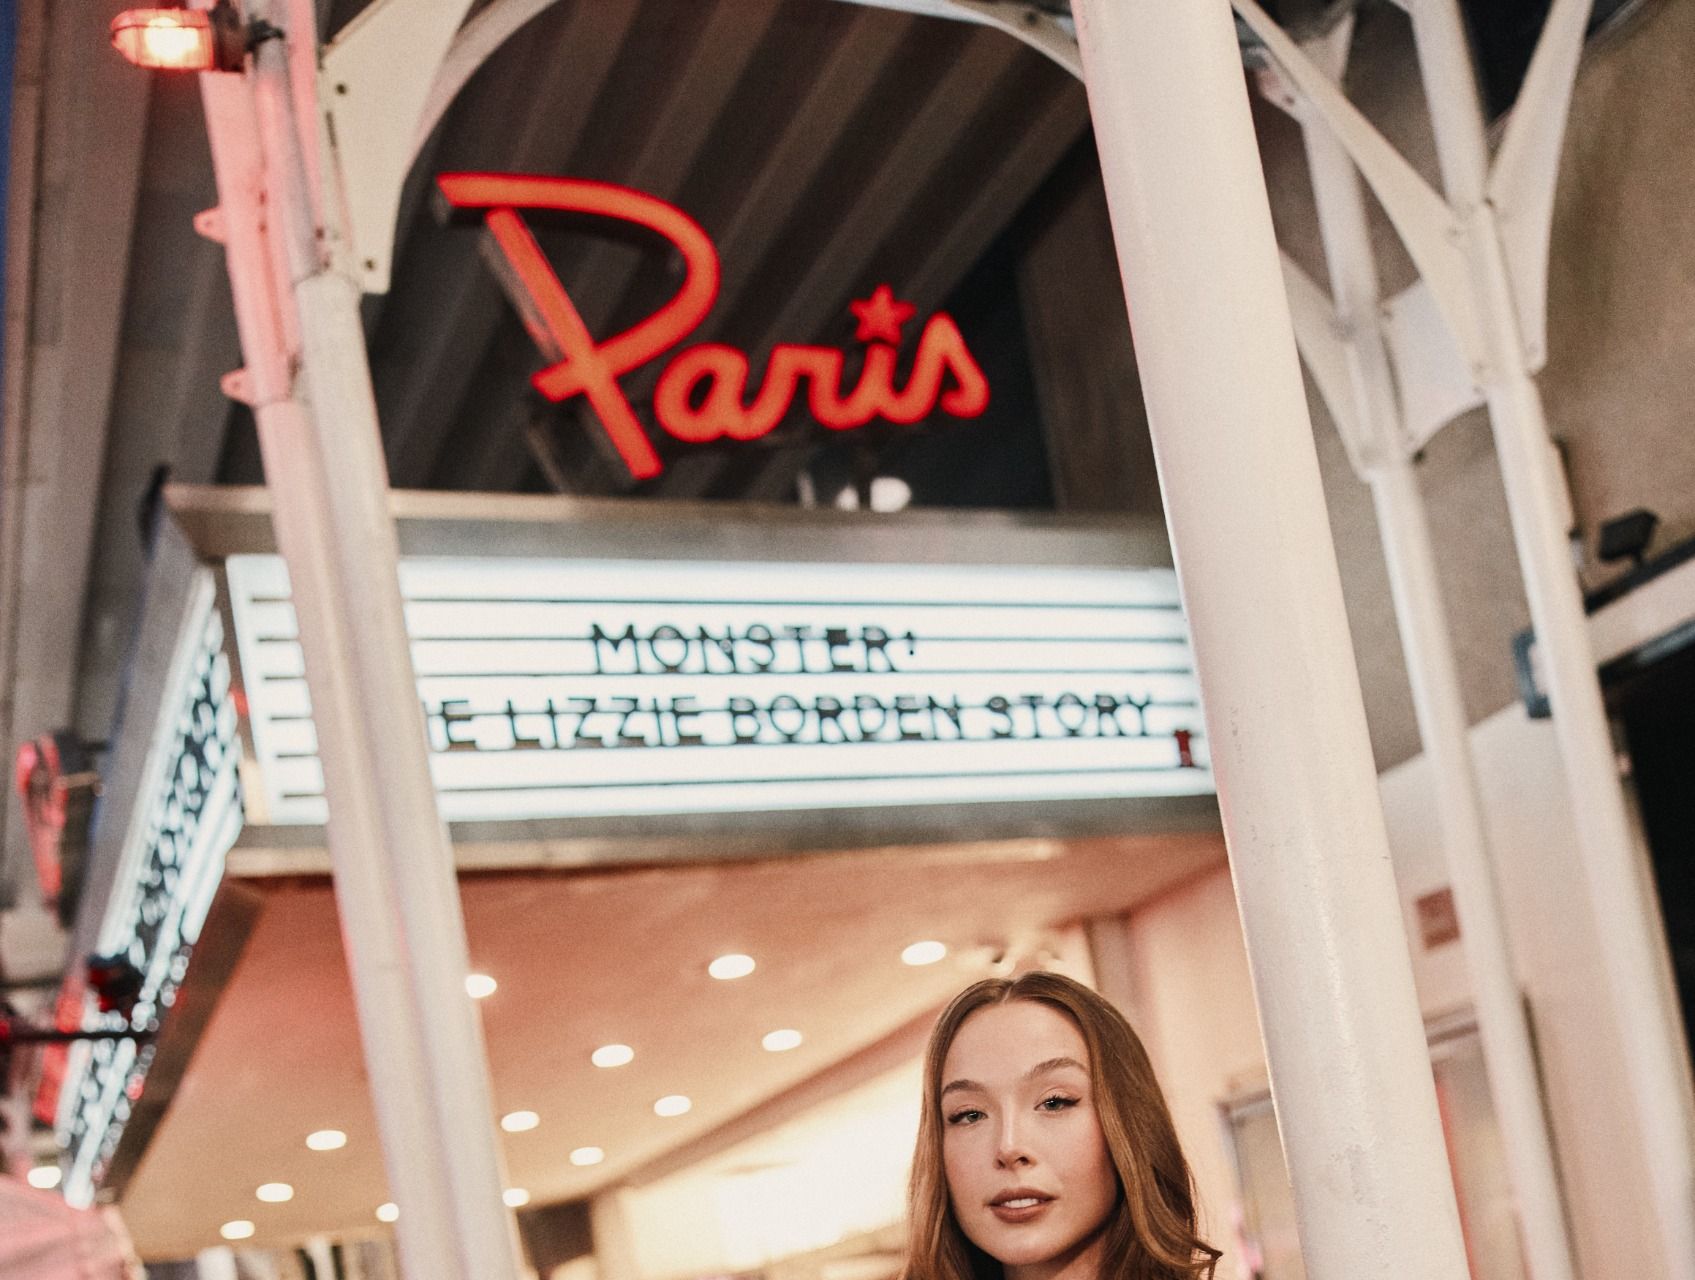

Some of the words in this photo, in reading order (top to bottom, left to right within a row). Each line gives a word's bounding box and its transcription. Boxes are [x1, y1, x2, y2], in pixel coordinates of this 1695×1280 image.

[436, 171, 990, 481] Paris
[506, 696, 703, 748] LIZZIE
[727, 693, 964, 744] BORDEN
[985, 691, 1150, 738] STORY
